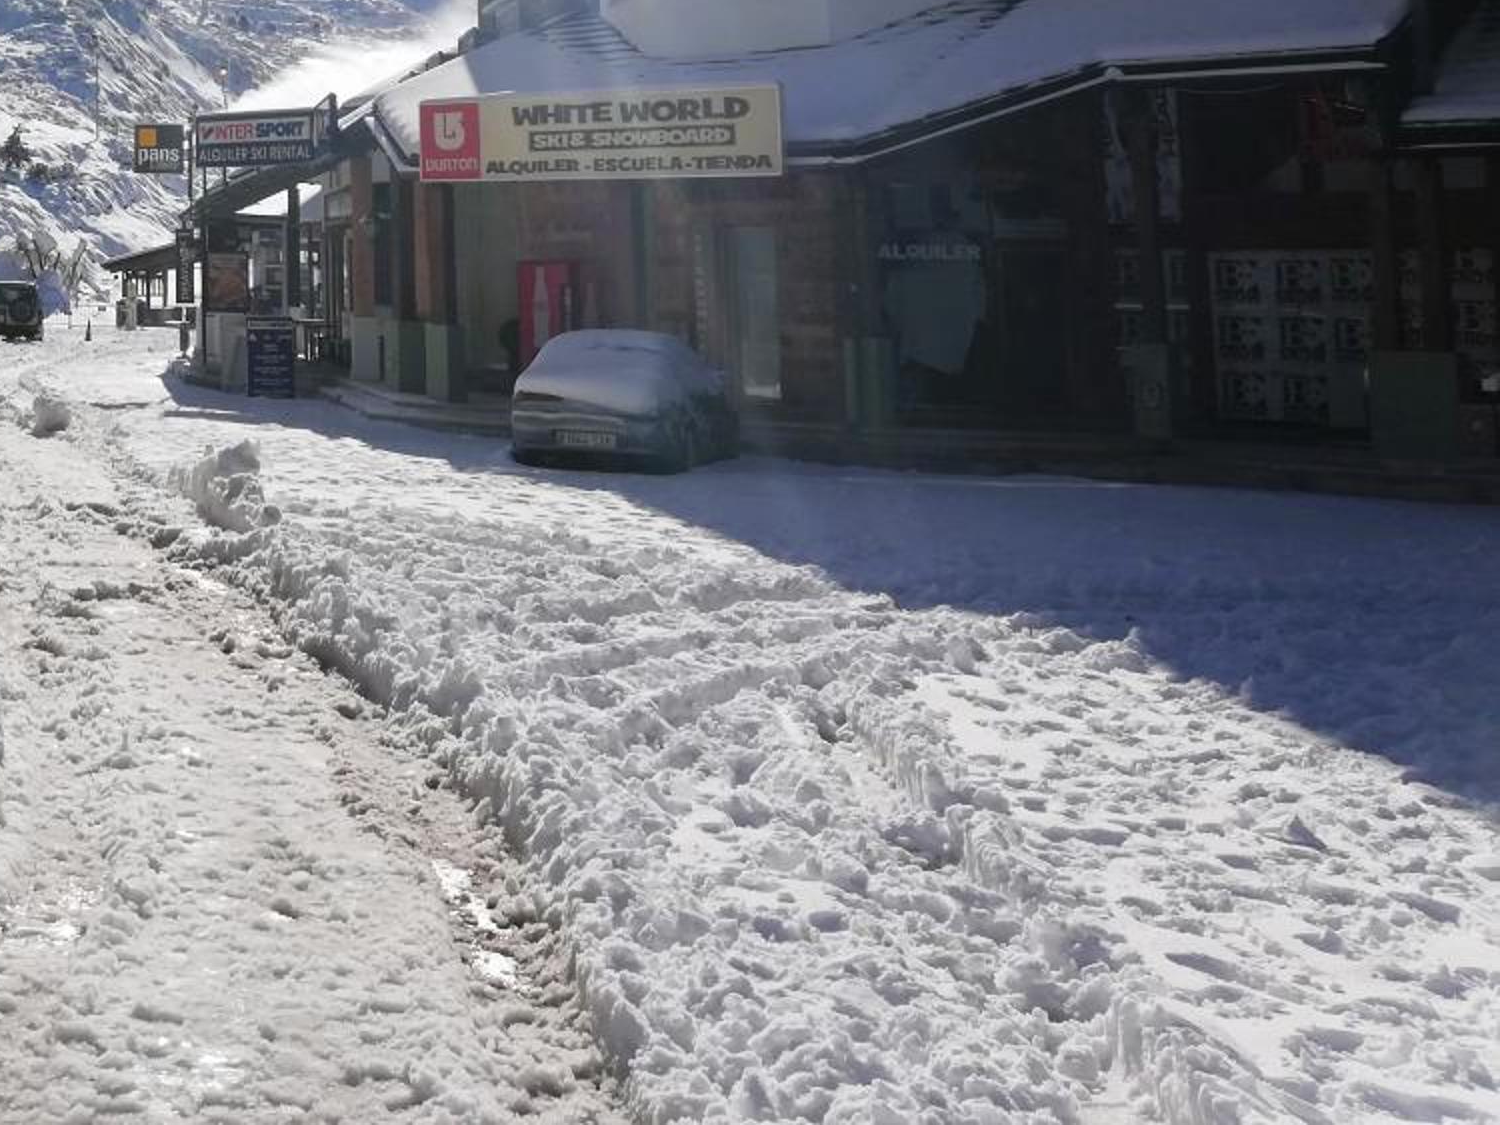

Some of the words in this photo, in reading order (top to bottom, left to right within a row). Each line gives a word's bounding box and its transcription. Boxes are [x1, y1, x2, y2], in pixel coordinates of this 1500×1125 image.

[512, 101, 613, 126] WHITE
[618, 96, 751, 123] WORLD
[592, 126, 731, 148] SNOWBOARD
[137, 148, 180, 166] pans
[269, 144, 311, 160] RENTAL
[486, 157, 580, 175] ALQUILER
[877, 242, 981, 260] ALQUILER
